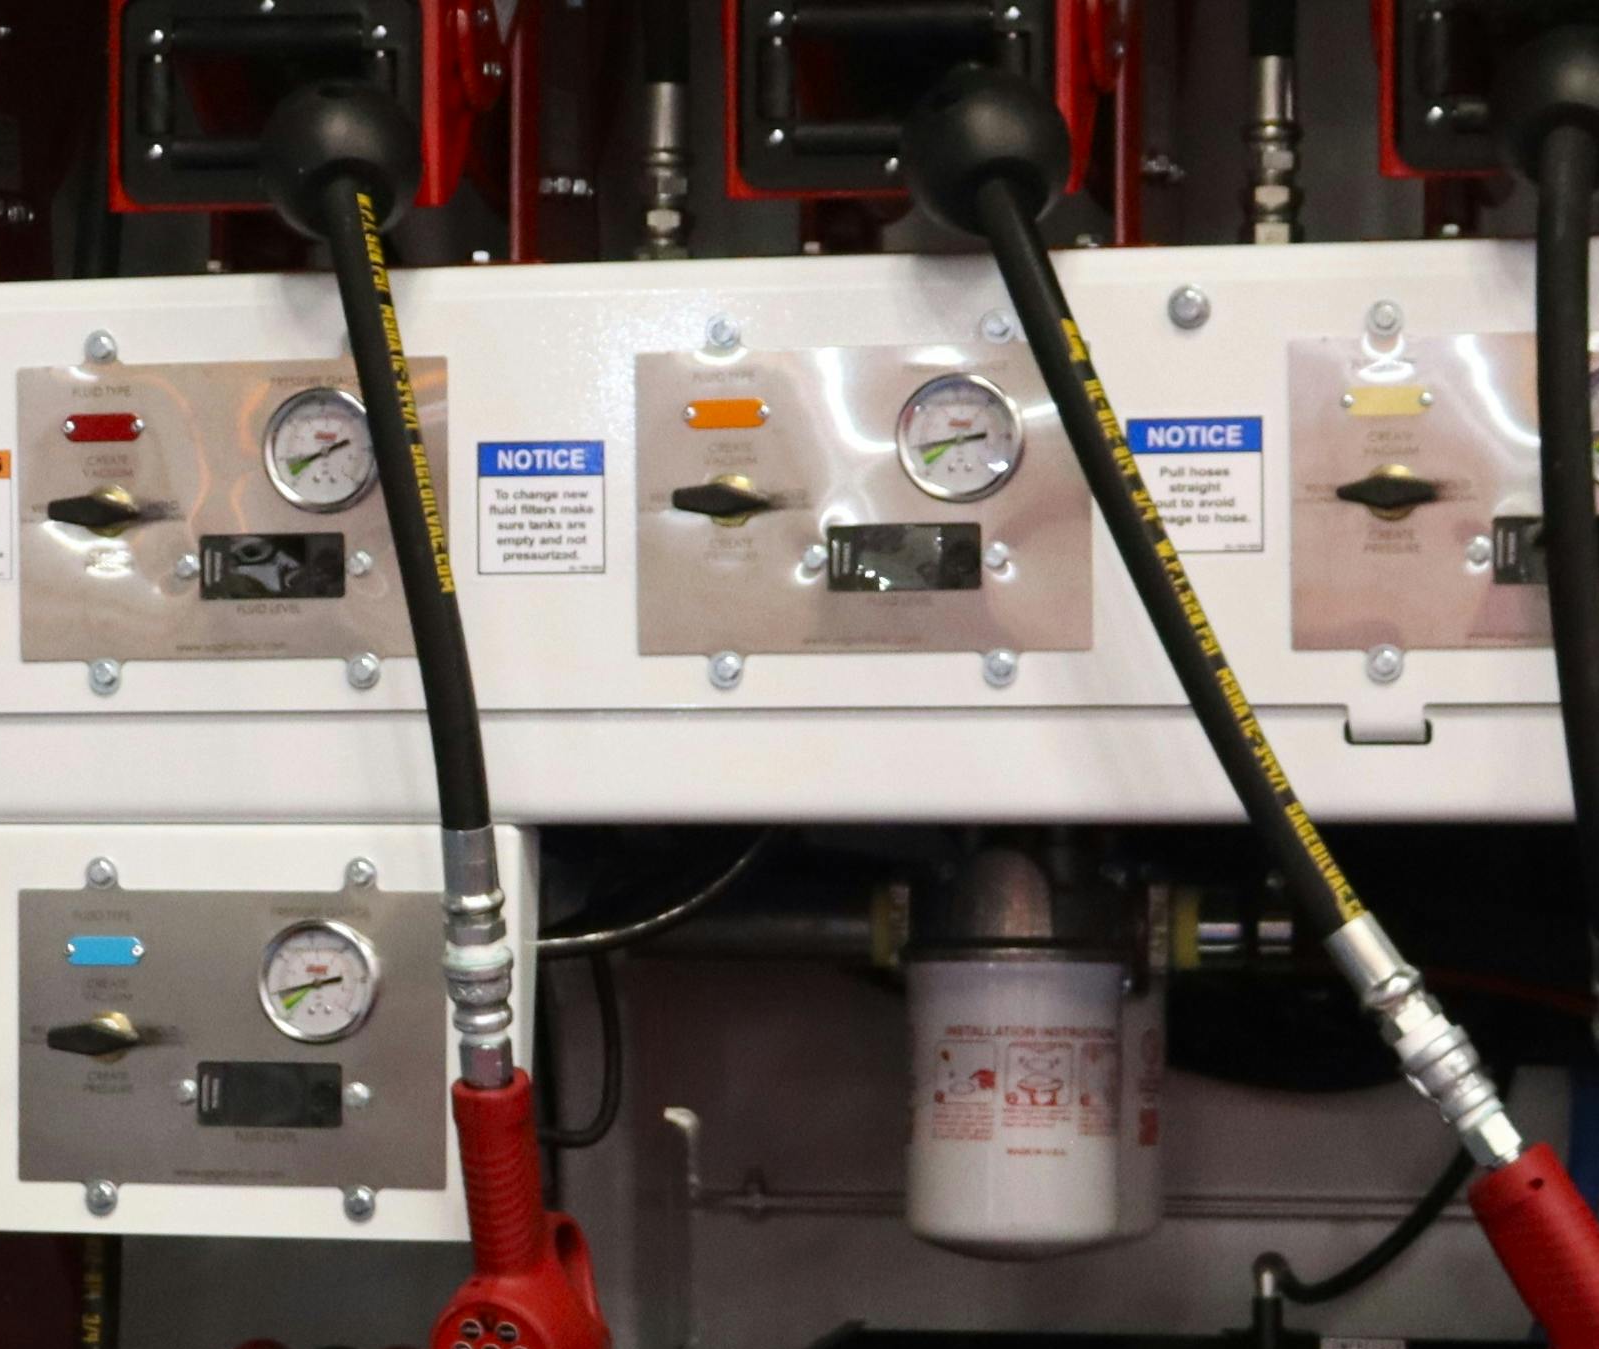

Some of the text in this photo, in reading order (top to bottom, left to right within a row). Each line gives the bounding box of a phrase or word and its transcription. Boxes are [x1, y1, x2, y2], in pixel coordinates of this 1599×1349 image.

[1146, 425, 1243, 448] NOTICE
[497, 448, 586, 470] NOTICE
[1159, 466, 1230, 477] Pull hoses
[1169, 482, 1221, 494] straight
[495, 489, 588, 501] To change new
[1181, 498, 1193, 508] to
[1199, 498, 1235, 508] avoid
[489, 504, 594, 514] fluid filters make
[1197, 513, 1209, 523] to
[497, 520, 586, 530] sure tanks are
[497, 535, 587, 547] empty and not
